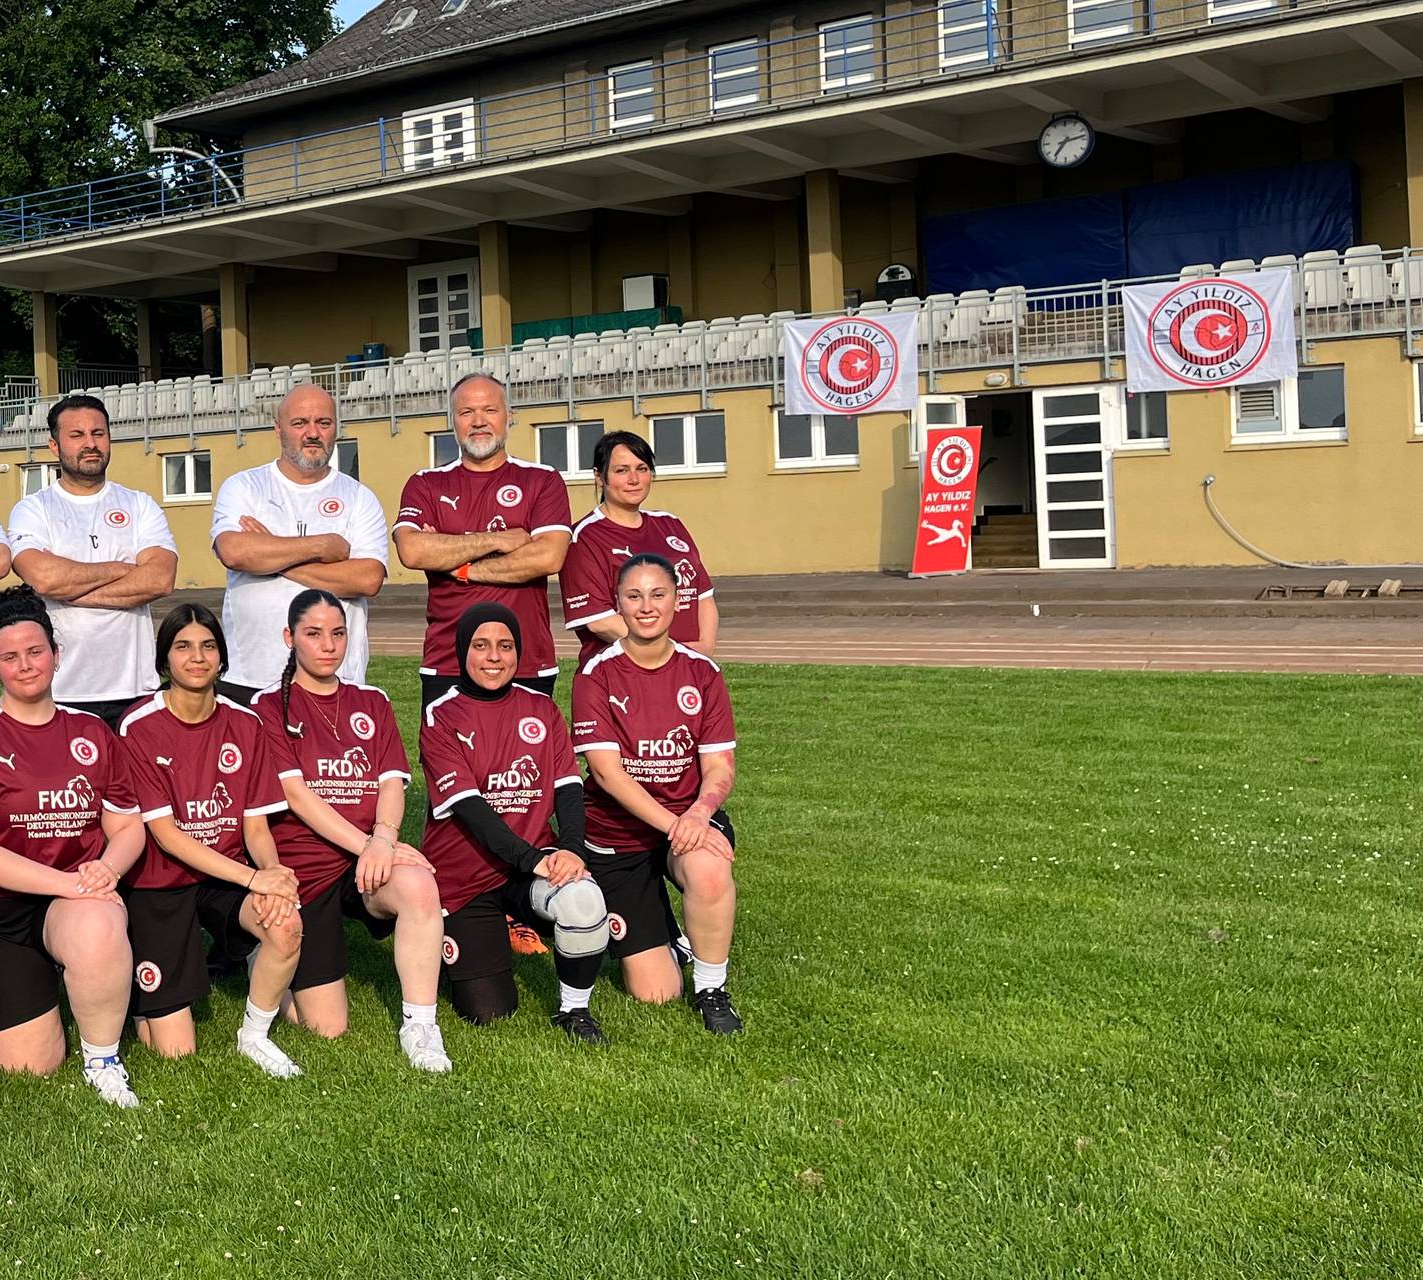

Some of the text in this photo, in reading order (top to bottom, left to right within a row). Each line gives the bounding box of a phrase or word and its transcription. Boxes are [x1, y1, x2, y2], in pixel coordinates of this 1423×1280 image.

[1165, 287, 1253, 319] AY YILDIZ
[817, 325, 886, 351] AY YILDIZ
[1180, 359, 1241, 378] HAGEN
[825, 390, 873, 406] HAGEN
[925, 490, 972, 502] AY YILDIZ
[924, 504, 952, 514] HAGEN
[638, 739, 676, 757] FKD
[317, 758, 354, 777] FKD
[626, 766, 684, 775] DEUTSCHLAND
[488, 770, 521, 790] FKD
[38, 789, 78, 810] FKD
[186, 799, 218, 820] FKD
[26, 819, 87, 830] DEUTSCHLAND
